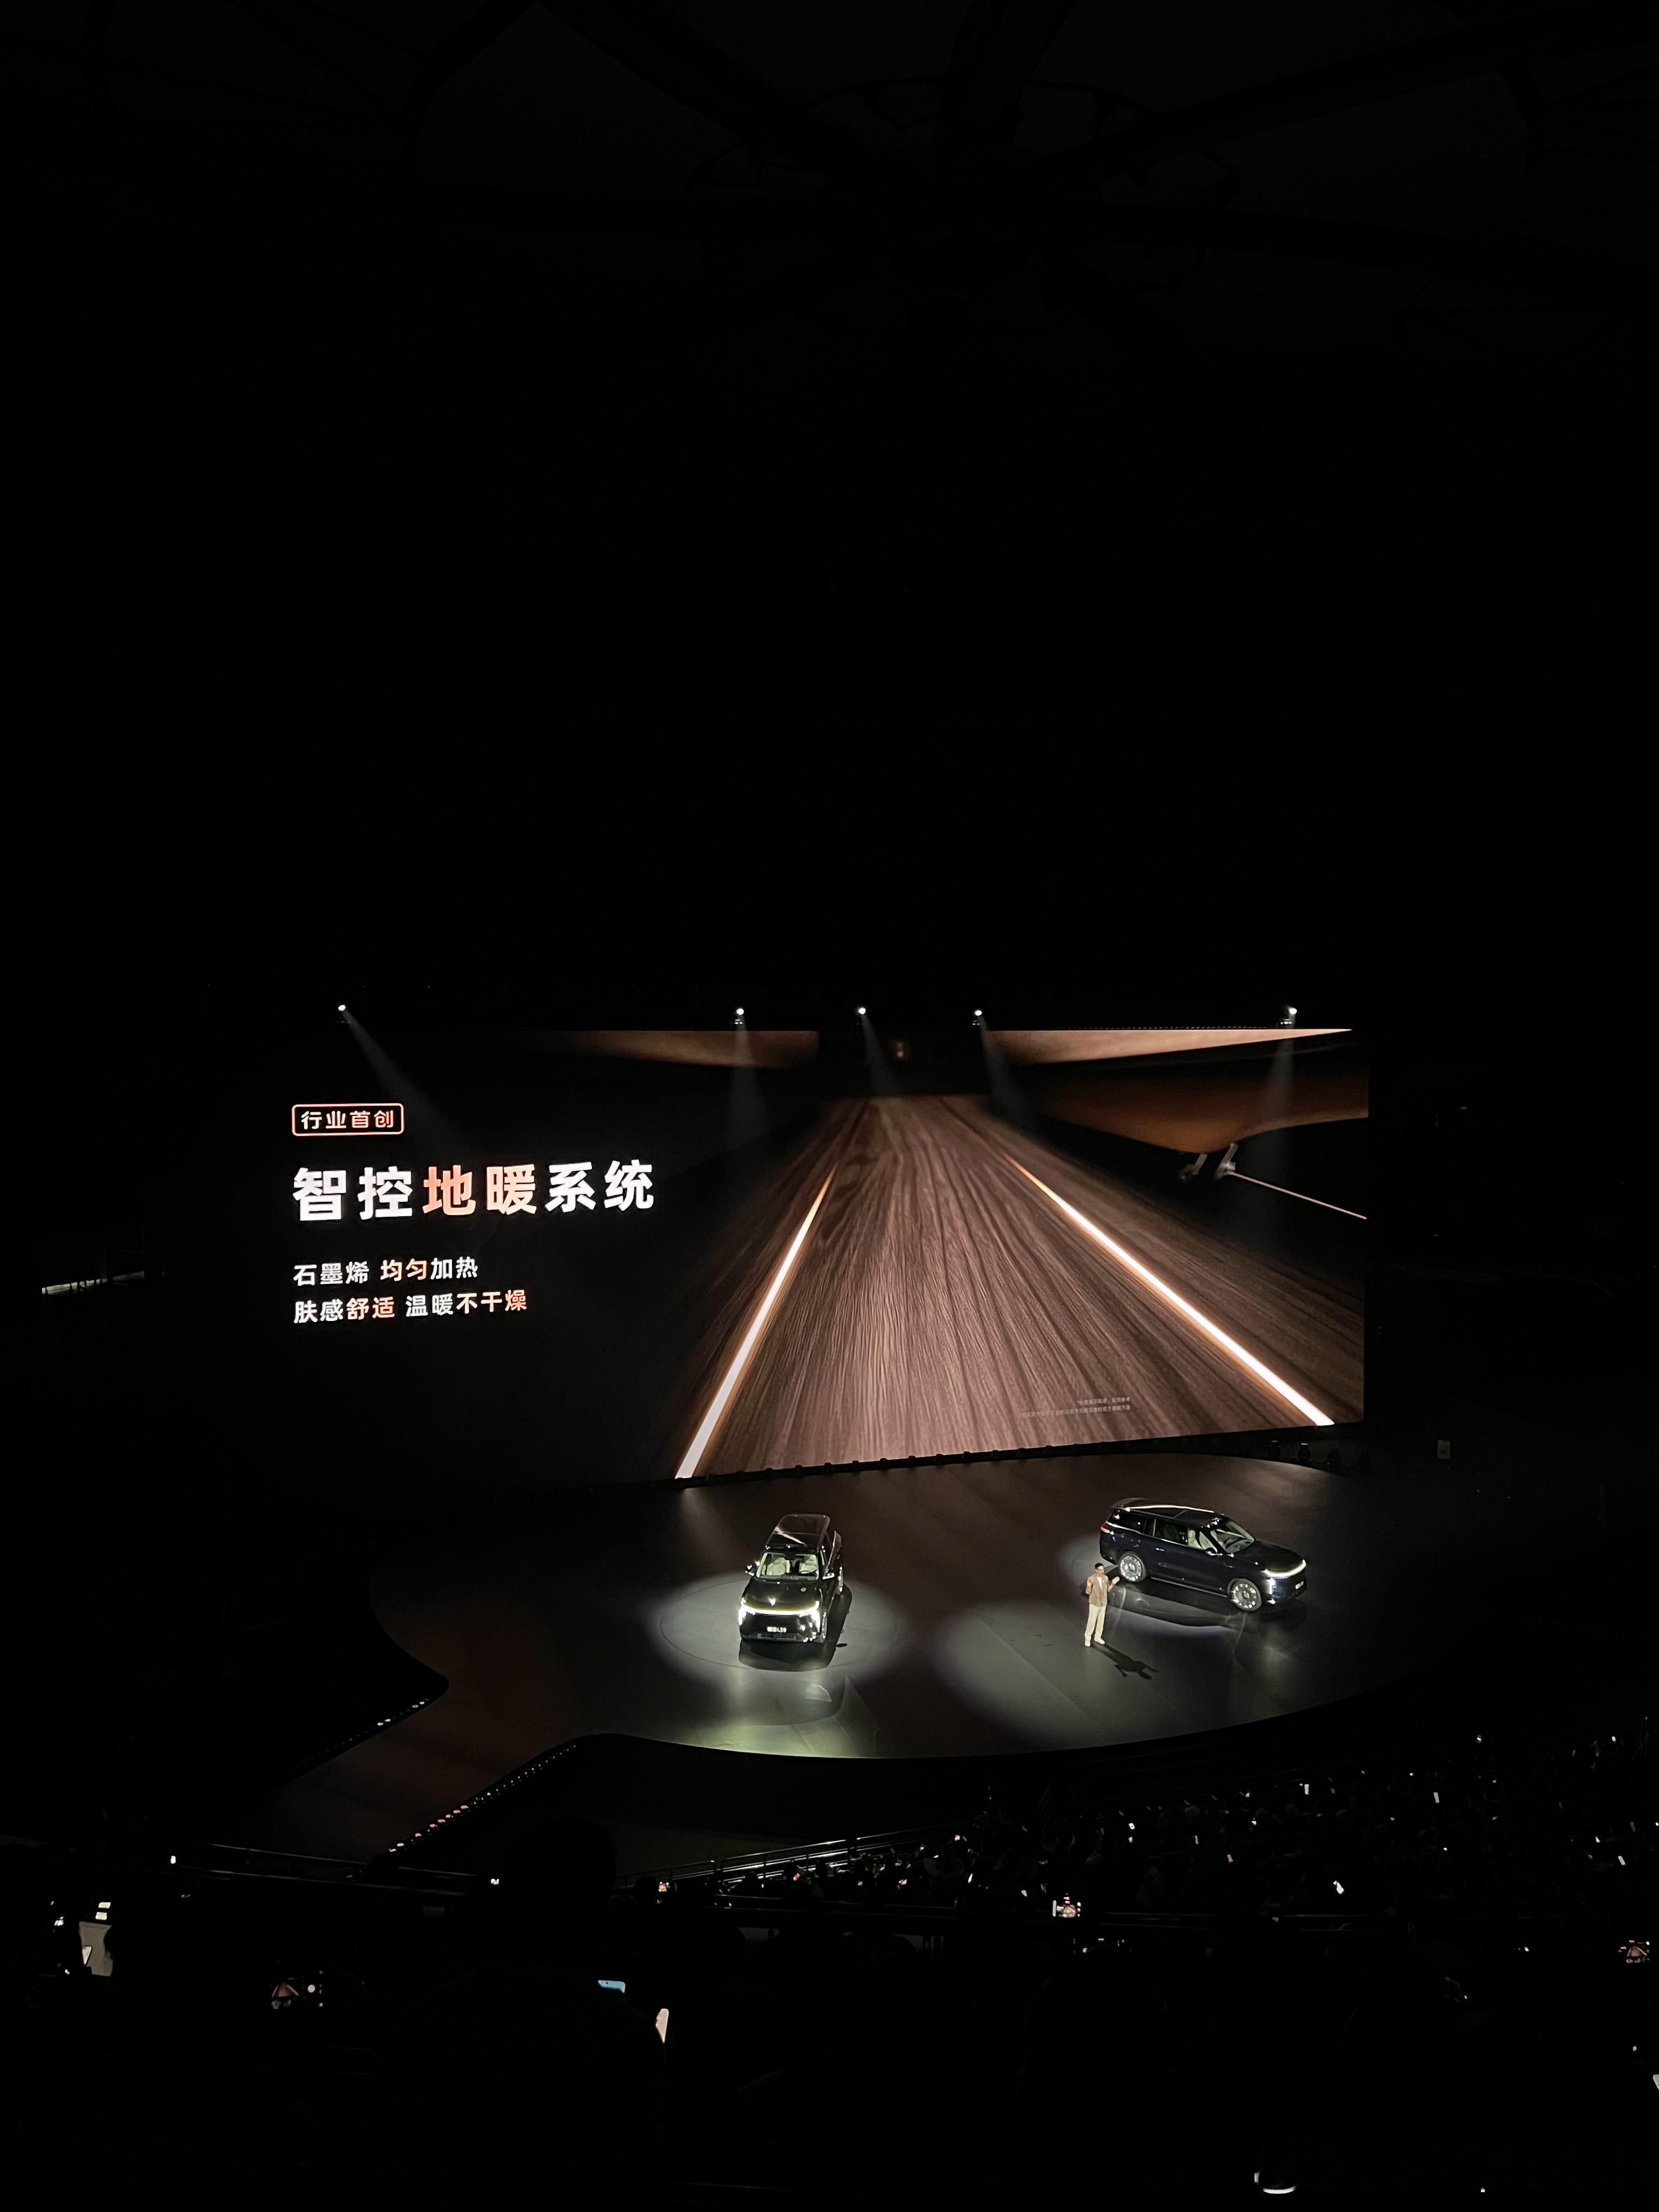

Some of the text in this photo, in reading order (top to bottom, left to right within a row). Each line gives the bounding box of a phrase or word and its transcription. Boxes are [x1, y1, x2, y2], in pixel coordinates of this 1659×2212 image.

[301, 1110, 394, 1130] 行业首创
[293, 1159, 654, 1221] 智控地暖系统
[294, 1256, 478, 1286] 石墨烯 均匀加热
[294, 1290, 527, 1324] 肤感舒适 温暖不干燥
